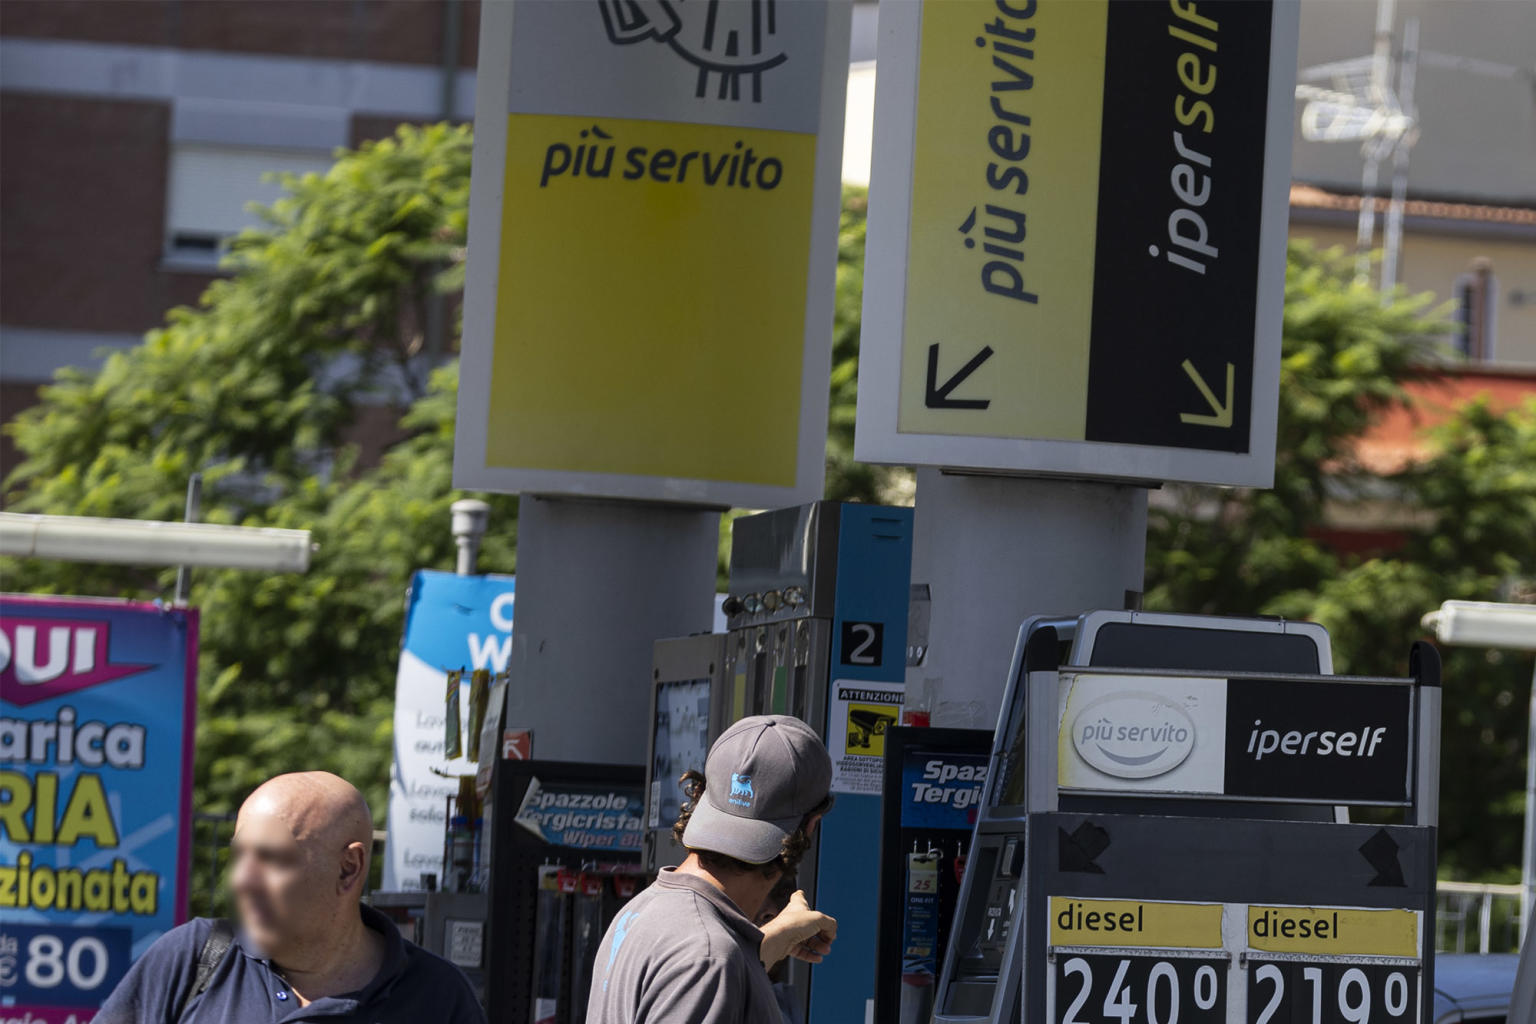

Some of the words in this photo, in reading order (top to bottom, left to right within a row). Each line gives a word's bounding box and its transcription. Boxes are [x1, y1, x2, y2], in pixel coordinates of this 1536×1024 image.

[539, 125, 613, 188] più
[623, 140, 783, 191] servito
[1149, 0, 1220, 275] iperself
[958, 206, 1039, 305] più
[850, 623, 875, 664] 2
[1081, 717, 1112, 746] più
[1116, 722, 1188, 746] servito
[1246, 719, 1387, 761] iperself
[1057, 904, 1144, 932] diesel
[1252, 911, 1338, 939] diesel
[26, 935, 109, 990] 80
